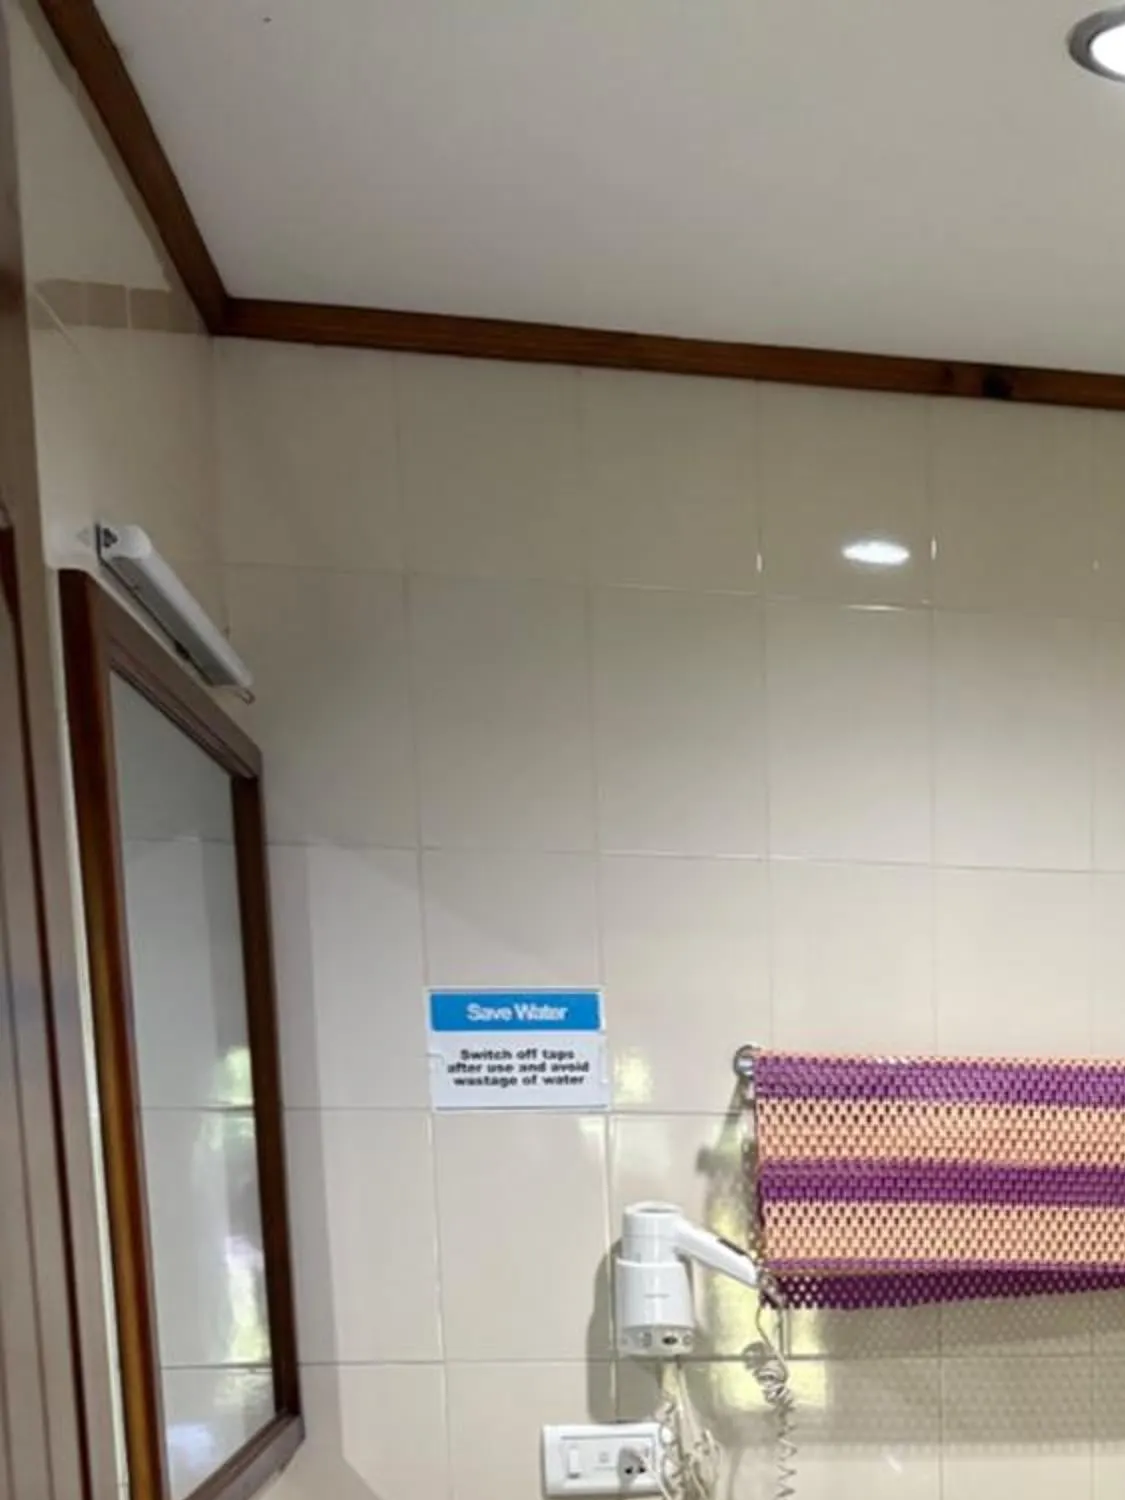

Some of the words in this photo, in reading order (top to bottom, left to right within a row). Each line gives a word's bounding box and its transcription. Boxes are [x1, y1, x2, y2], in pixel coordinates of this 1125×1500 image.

[466, 1002, 512, 1021] Save
[514, 1002, 568, 1021] Water
[460, 1048, 512, 1060] Switch
[516, 1048, 537, 1060] off
[542, 1049, 575, 1062] taps
[447, 1062, 482, 1073] after
[487, 1063, 514, 1073] use
[519, 1061, 546, 1073] and
[551, 1061, 590, 1073] avoid
[453, 1075, 518, 1088] wastage
[522, 1074, 538, 1086] of
[542, 1075, 585, 1086] water
